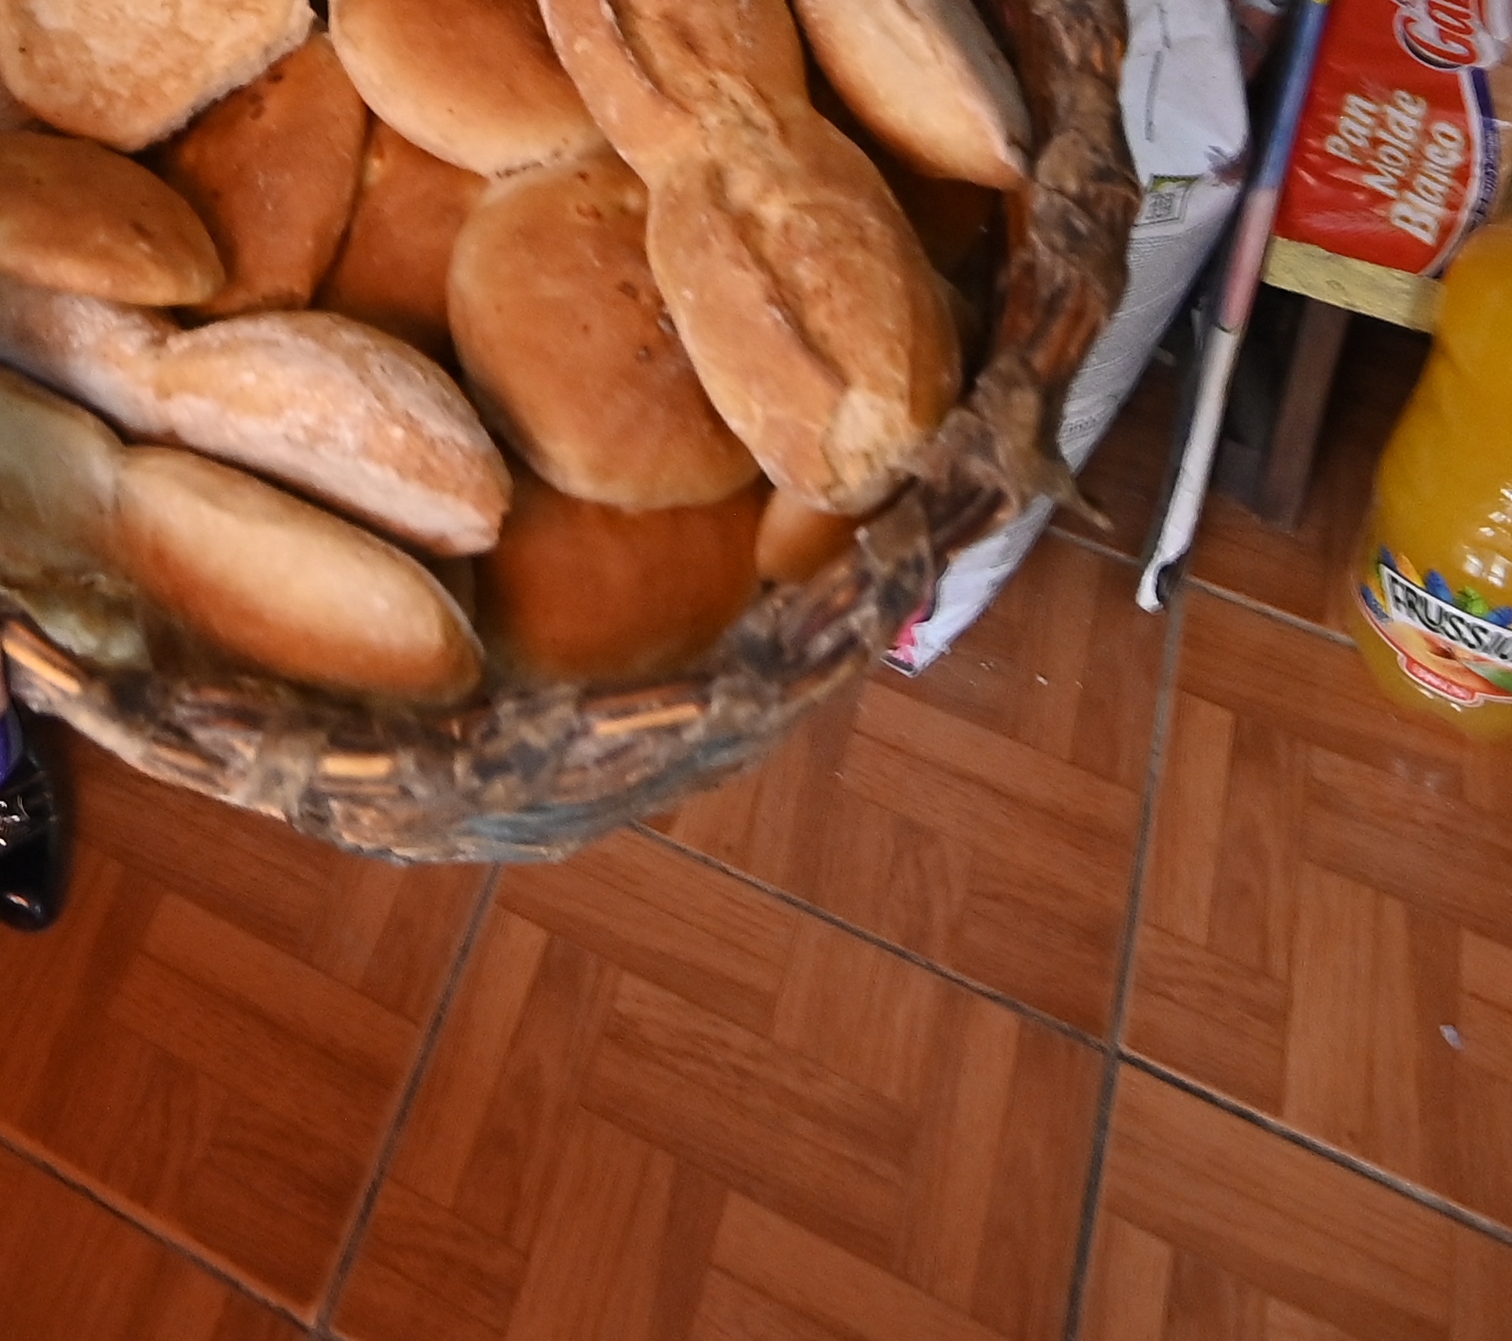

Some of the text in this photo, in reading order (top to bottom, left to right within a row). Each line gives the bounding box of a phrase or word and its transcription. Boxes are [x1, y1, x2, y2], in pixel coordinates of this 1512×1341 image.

[1325, 92, 1379, 165] Pan
[1361, 88, 1426, 199] Molde
[1389, 120, 1467, 247] Blanco
